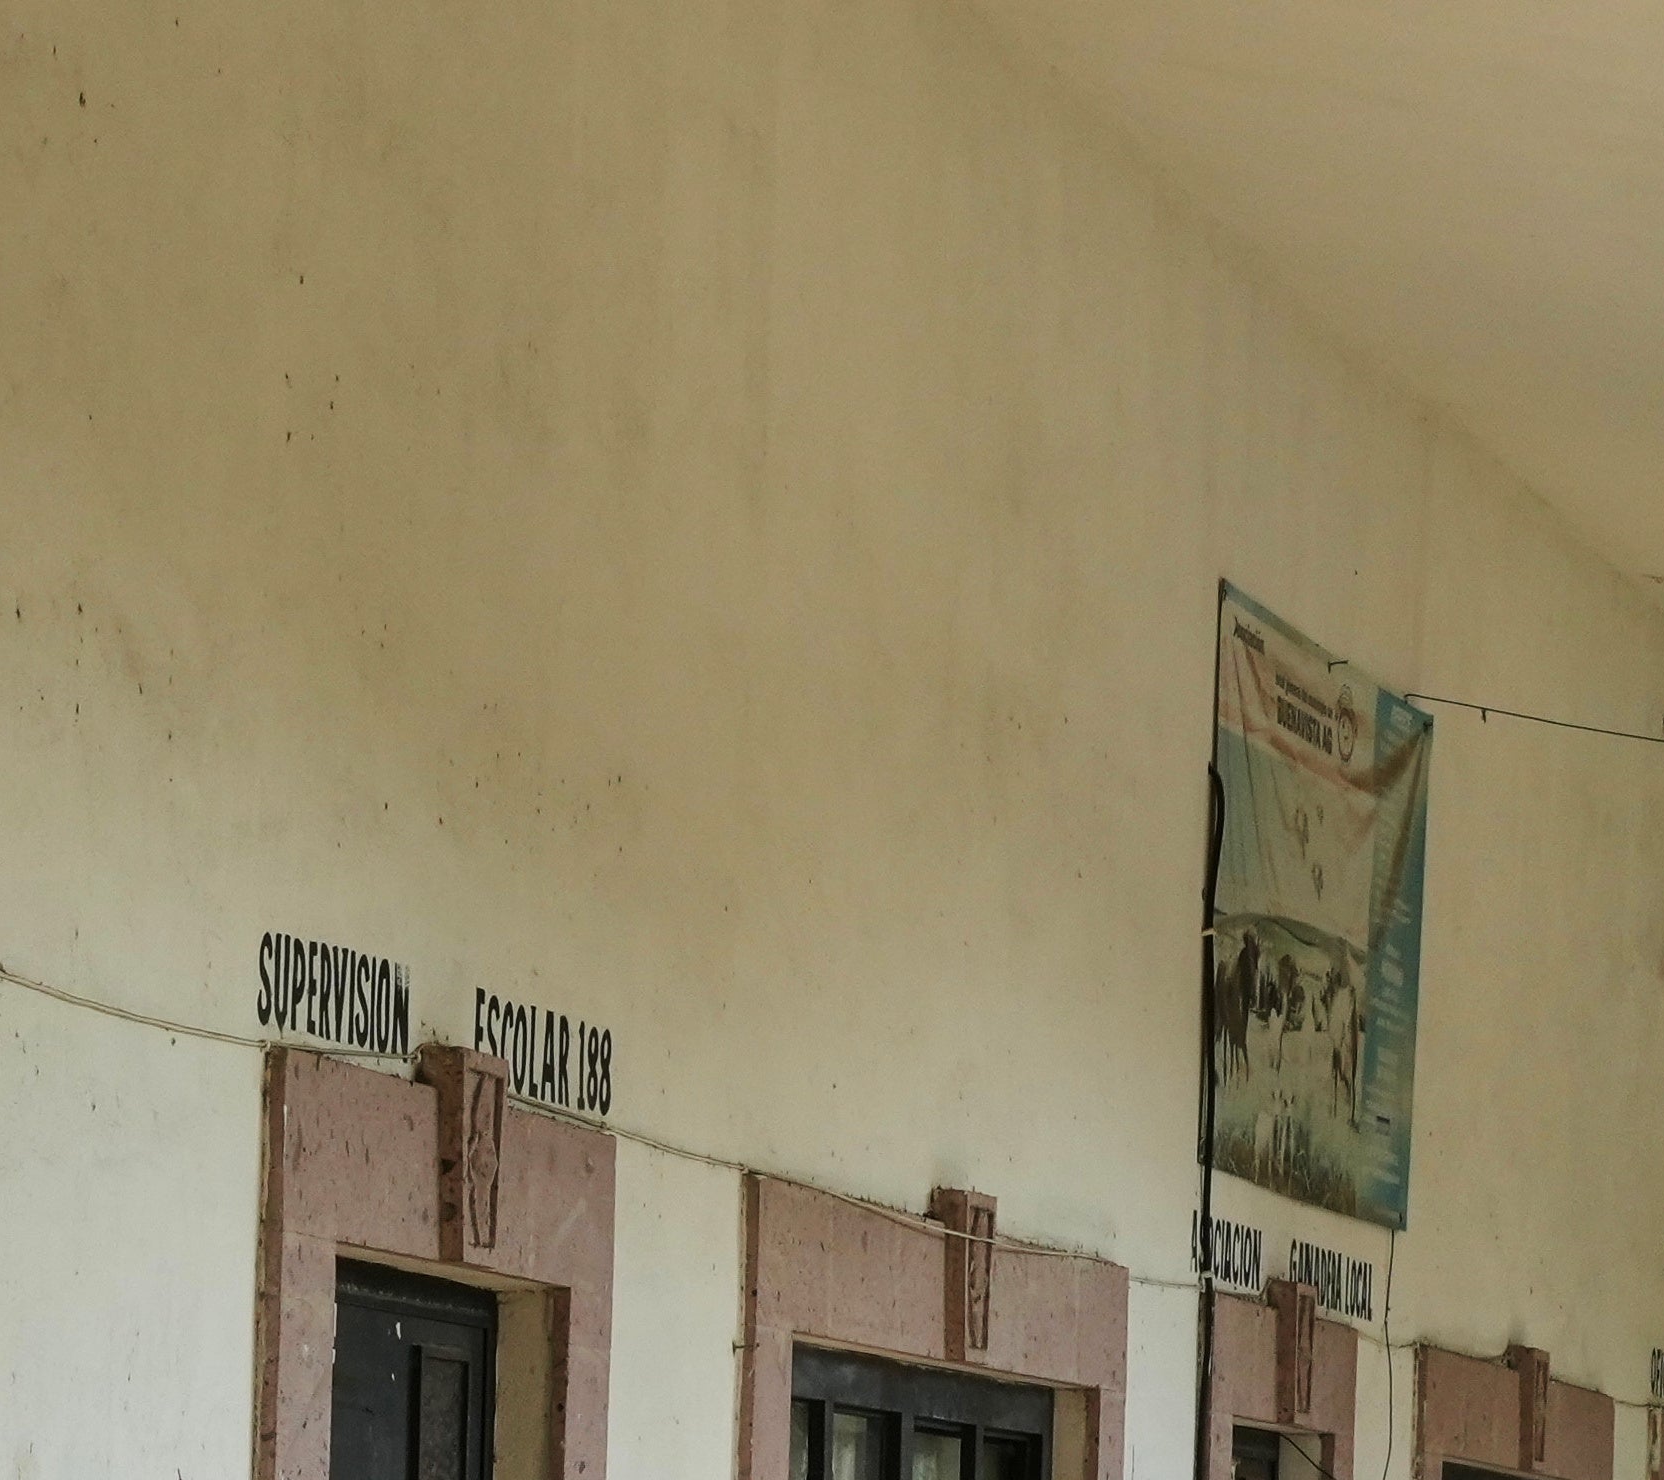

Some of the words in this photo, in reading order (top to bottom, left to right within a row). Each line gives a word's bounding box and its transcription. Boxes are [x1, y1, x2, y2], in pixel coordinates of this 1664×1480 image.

[257, 932, 410, 1058] SUPERVISION
[474, 987, 570, 1108] ESCOLAR
[577, 1020, 612, 1116] 188
[1344, 1256, 1373, 1321] LOCAL
